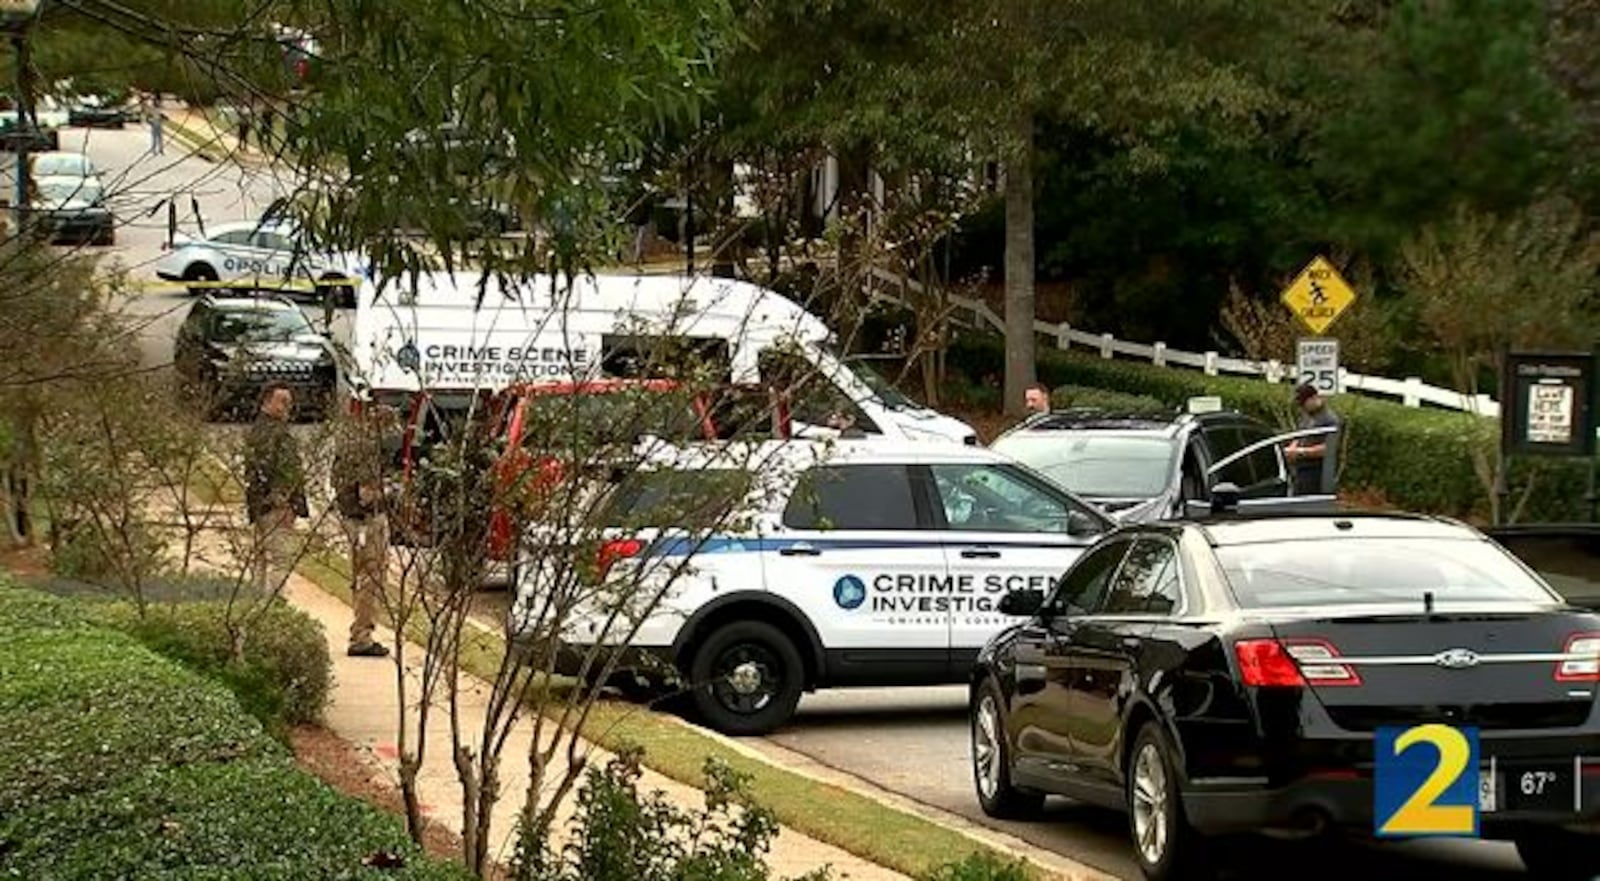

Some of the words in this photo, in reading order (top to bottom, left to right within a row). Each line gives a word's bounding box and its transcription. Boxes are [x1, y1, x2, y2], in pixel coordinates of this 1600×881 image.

[425, 344, 501, 361] CRIME
[508, 346, 586, 363] SCENE
[1301, 344, 1336, 355] SPEED
[1301, 370, 1334, 391] 25
[872, 574, 975, 593] CRIME
